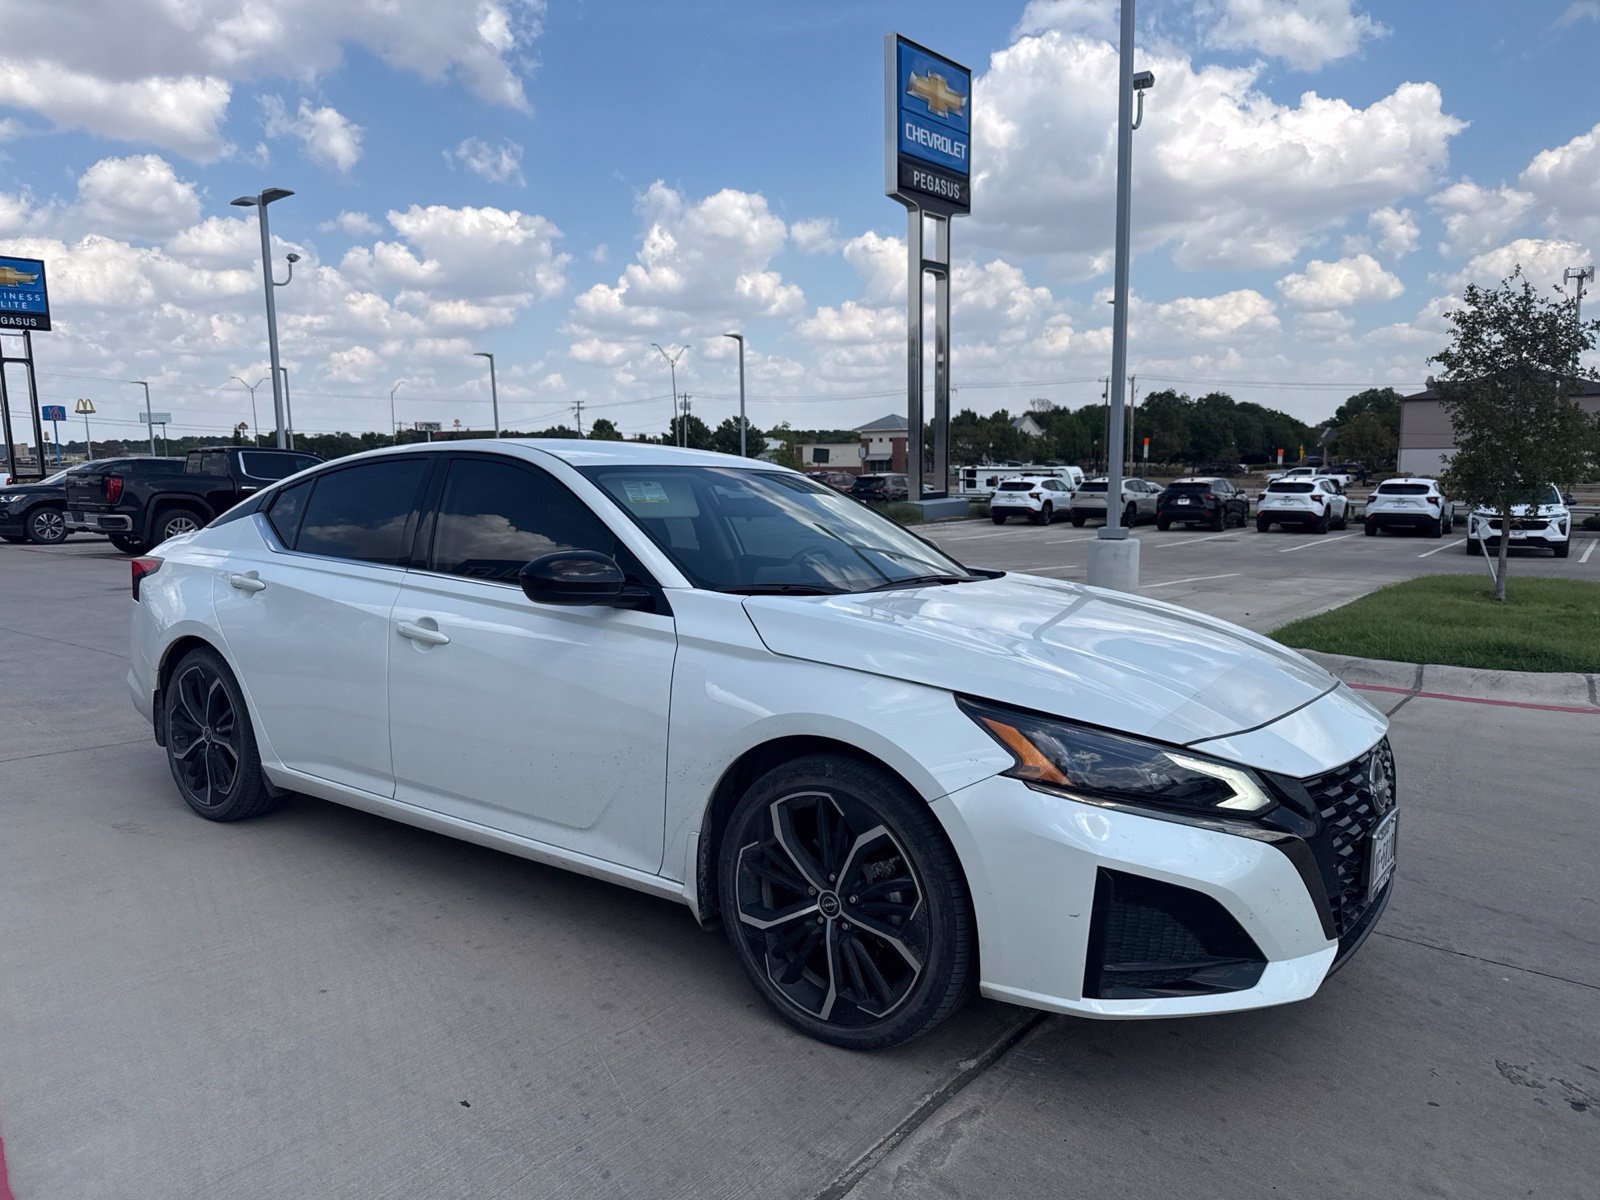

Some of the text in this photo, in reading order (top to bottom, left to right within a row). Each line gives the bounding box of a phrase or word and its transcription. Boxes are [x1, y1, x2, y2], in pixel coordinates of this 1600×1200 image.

[905, 122, 967, 160] CHEVROLET
[913, 170, 960, 200] PEGASUS
[0, 292, 41, 302] INESS
[0, 301, 28, 310] LITE
[0, 316, 37, 327] GASUS
[50, 406, 62, 421] 6
